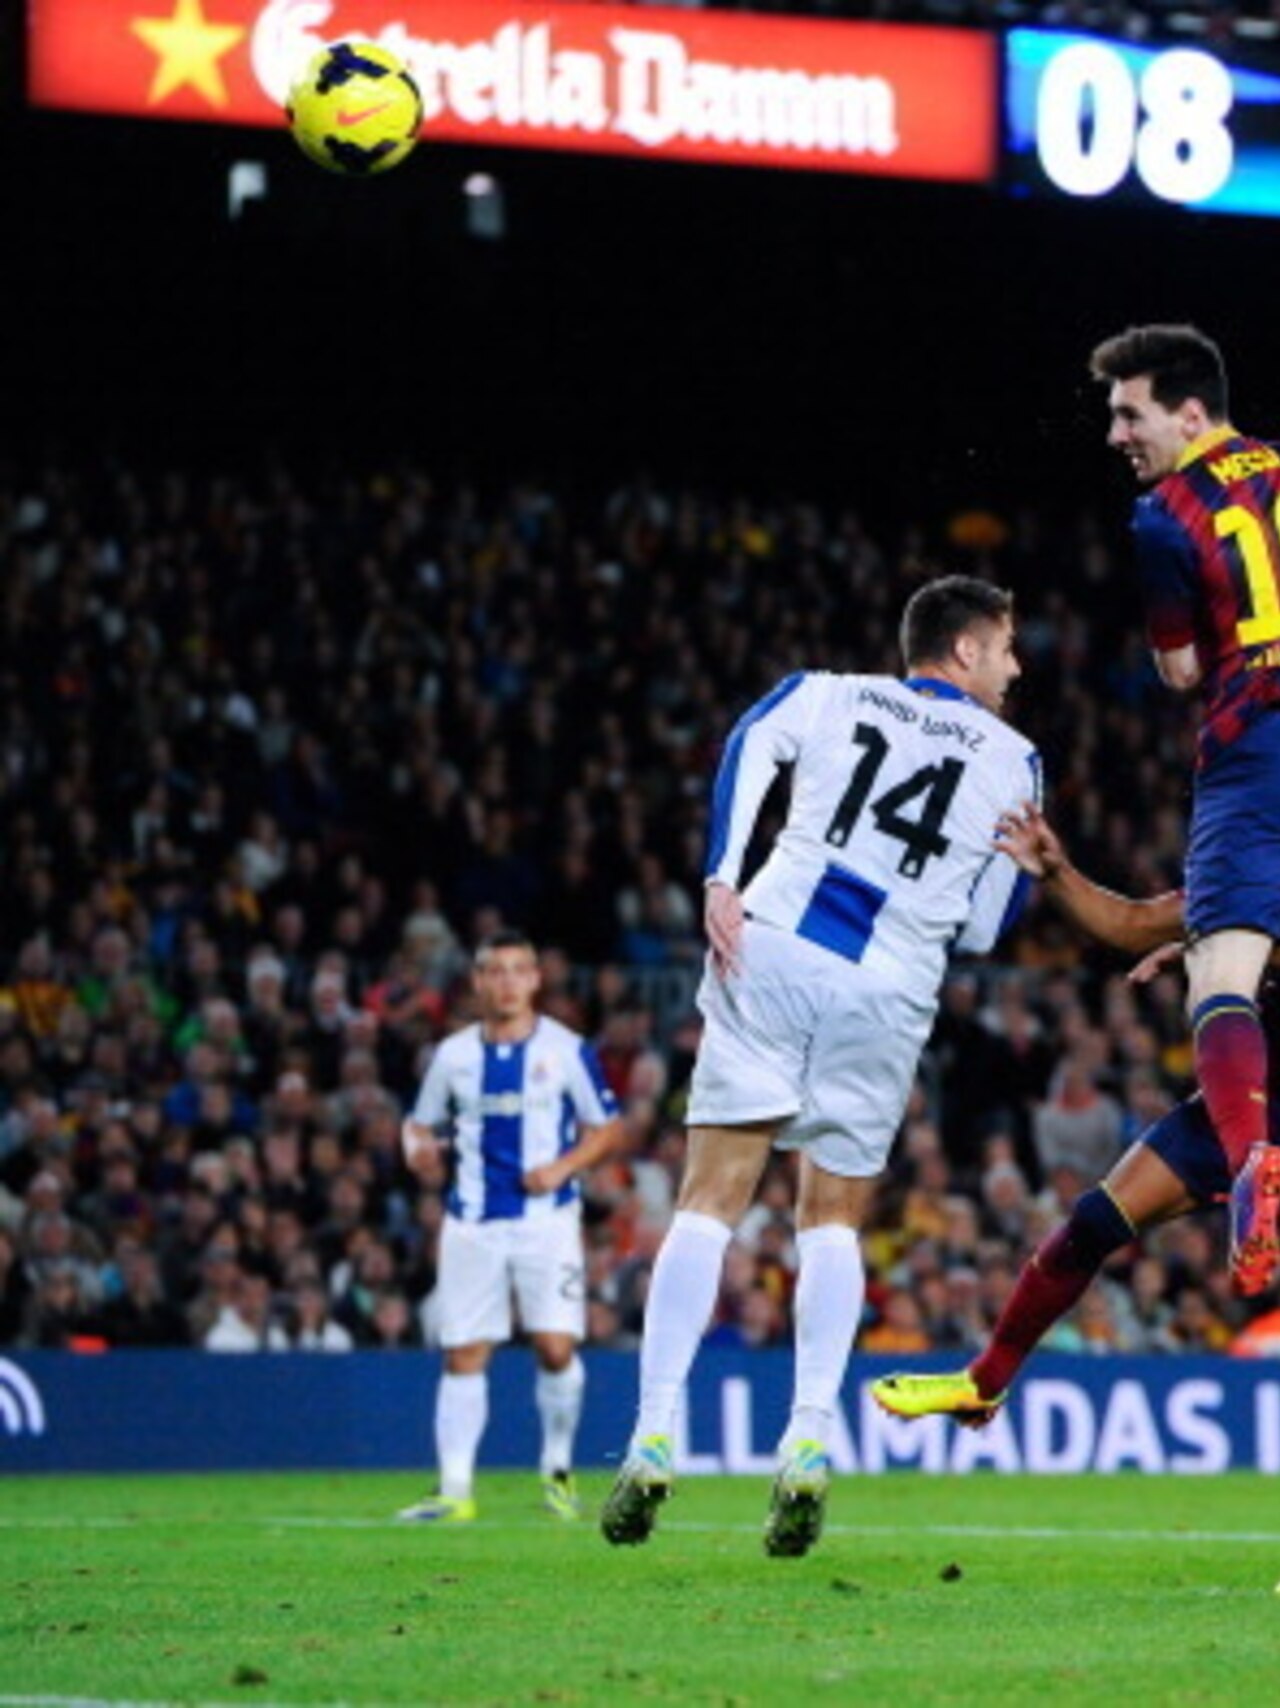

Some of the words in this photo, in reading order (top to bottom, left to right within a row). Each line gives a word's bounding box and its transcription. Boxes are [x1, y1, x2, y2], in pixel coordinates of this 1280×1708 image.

[253, 0, 606, 133] Etrella
[608, 27, 900, 157] Damm
[1036, 42, 1235, 203] 08
[825, 721, 966, 881] 14
